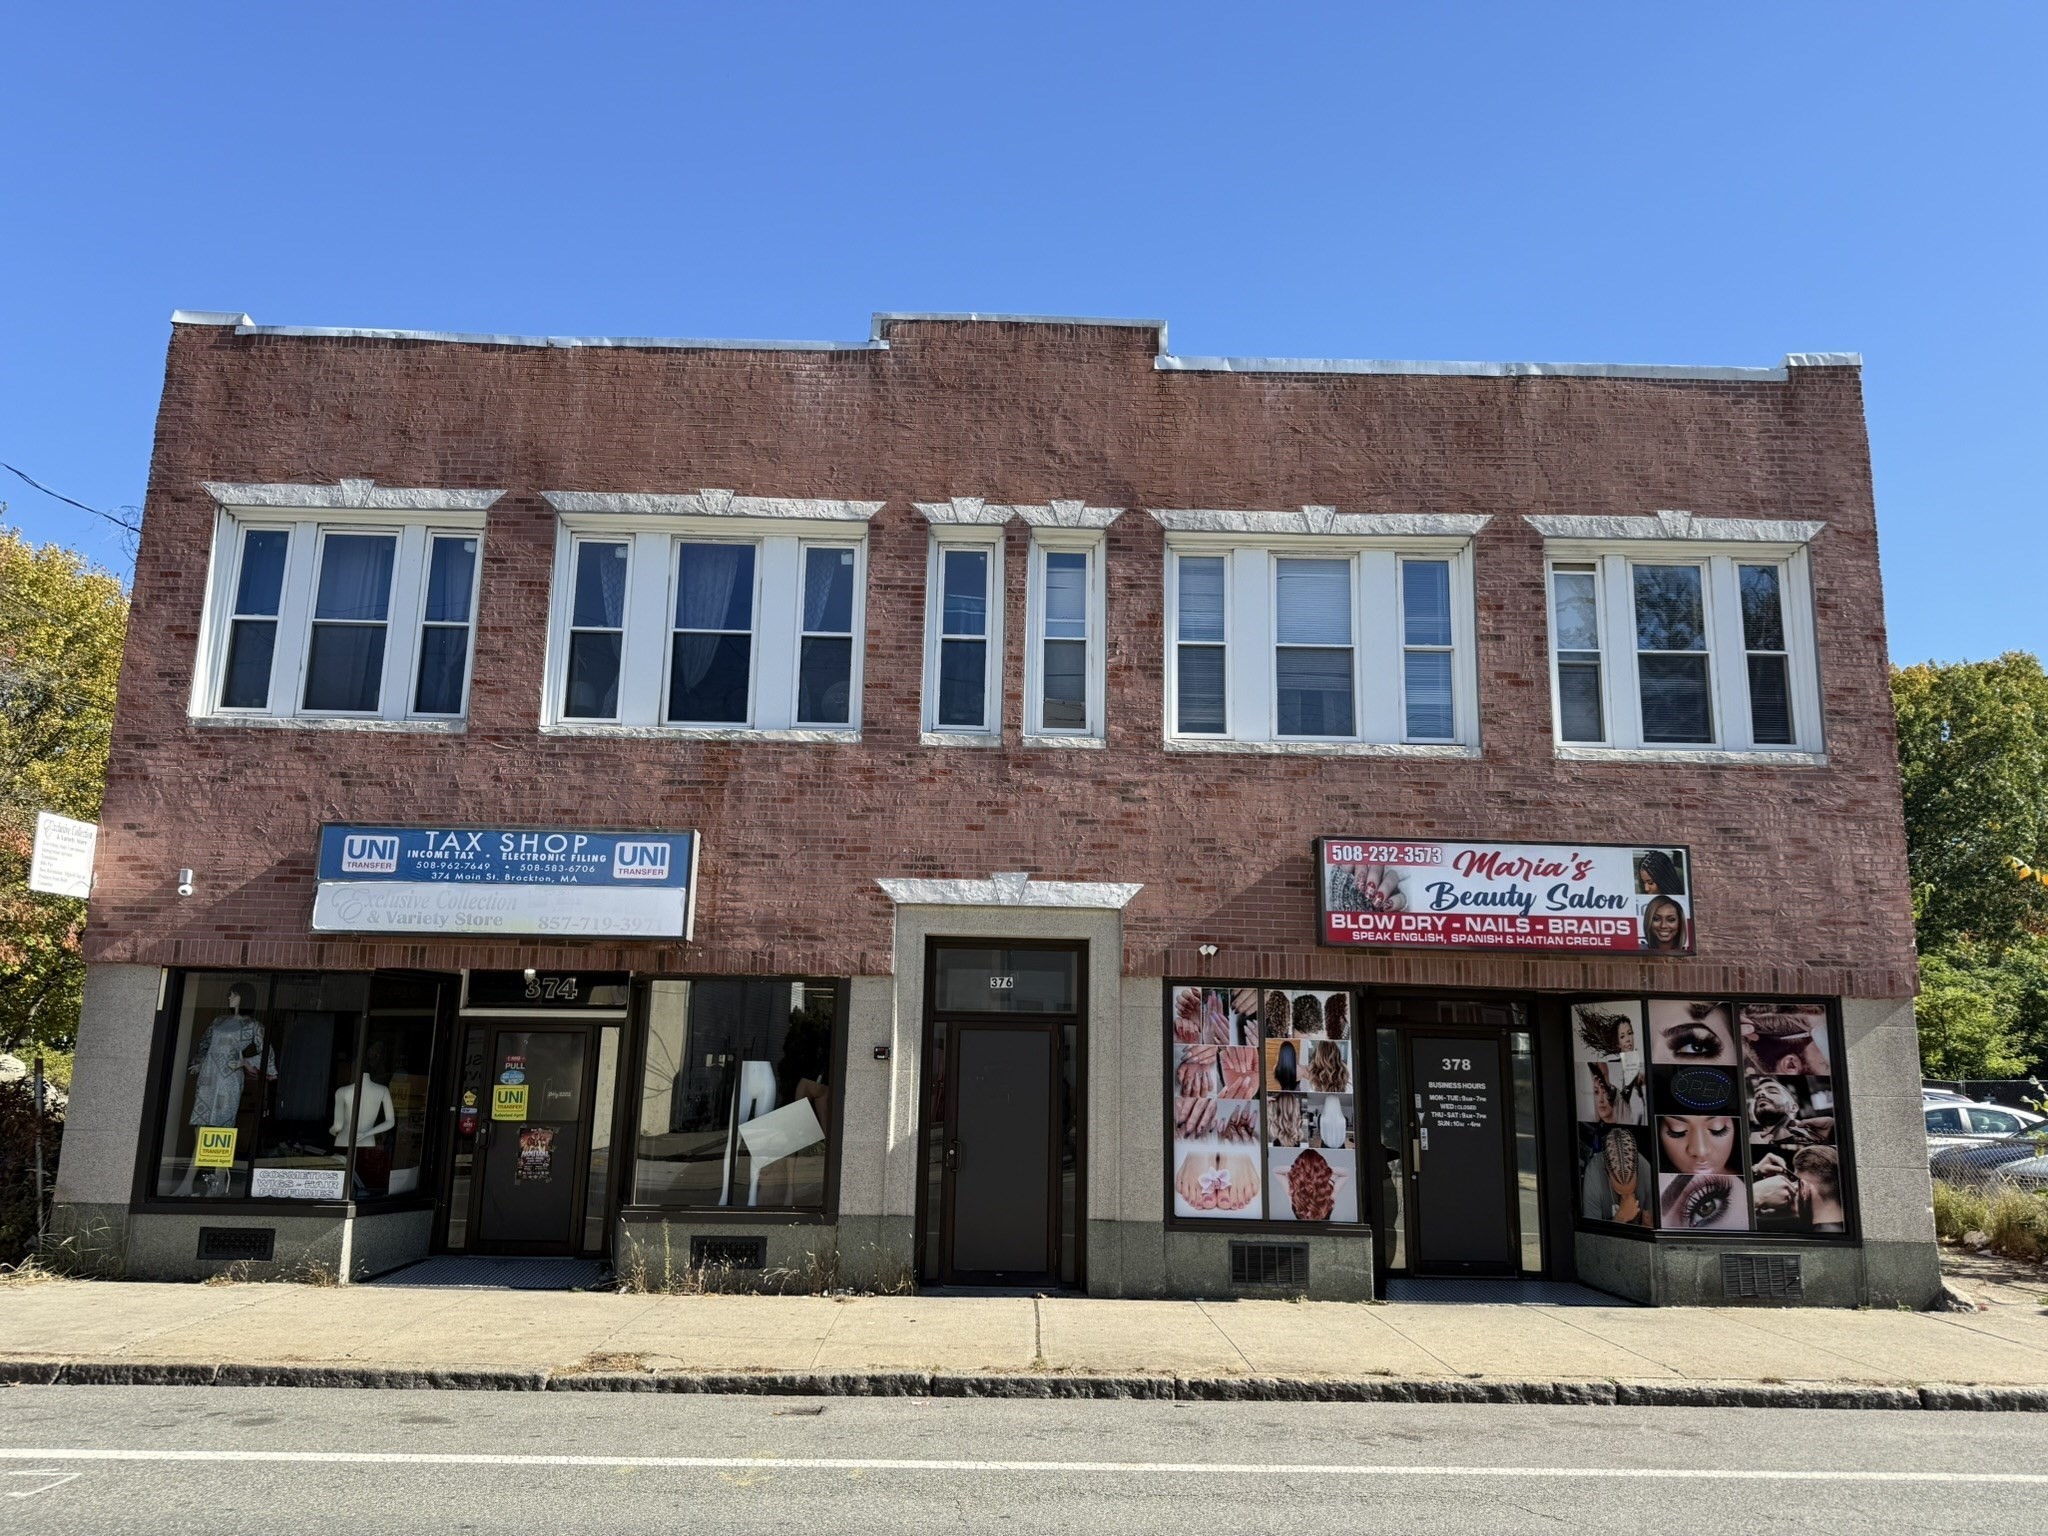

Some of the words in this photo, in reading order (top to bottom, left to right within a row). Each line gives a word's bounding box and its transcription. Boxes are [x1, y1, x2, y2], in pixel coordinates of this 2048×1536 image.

[347, 839, 396, 860] UNI
[425, 831, 483, 852] TAX
[500, 833, 588, 854] SHOP
[407, 850, 449, 859] INCOME
[454, 851, 474, 860] TAX
[502, 853, 566, 862] ELECTRONIC
[570, 854, 607, 863] FILING
[618, 845, 666, 867] UNI
[1332, 844, 1443, 864] 508-232-3573
[346, 861, 392, 869] TRANSFER
[416, 861, 491, 870] 508-962-7649
[520, 864, 595, 873] 508-583-6706
[618, 868, 664, 876] TRANSFER
[1452, 850, 1595, 882] Maria's
[431, 872, 450, 880] 374
[454, 873, 481, 881] Main
[486, 873, 499, 881] St.
[505, 874, 555, 883] Brockton,
[332, 888, 431, 924] Exclusive
[436, 888, 517, 911] Collection
[1425, 881, 1537, 917] Beauty
[1545, 883, 1629, 912] Salon
[367, 910, 379, 924] &
[386, 911, 449, 928] Variety
[454, 912, 503, 926] Store
[538, 916, 663, 932] 857-719-3971
[1331, 913, 1396, 930] BLOW
[1401, 915, 1447, 931] DRY
[1465, 917, 1531, 934] NAILS
[1548, 919, 1631, 935] BRAIDS
[1352, 931, 1391, 941] SPEAK
[1394, 932, 1447, 944] ENGLISH,
[1451, 934, 1504, 944] SPANISH
[1506, 936, 1514, 944] &
[1517, 936, 1564, 945] HAITIAN
[1566, 937, 1612, 946] CREOLE
[525, 977, 578, 999] 374
[991, 977, 1013, 988] 376
[505, 1062, 525, 1070] PULL
[1442, 1058, 1471, 1071] 378
[1428, 1081, 1462, 1089] BUSINESS
[1462, 1082, 1486, 1090] HOURS
[1676, 1078, 1728, 1099] OPEN
[497, 1090, 524, 1104] UNI
[203, 1133, 232, 1148] UNI
[259, 1170, 339, 1180] COSMETICS
[257, 1178, 294, 1188] WIGS
[304, 1180, 339, 1189] HAIR
[259, 1188, 335, 1198] PERFUMES
